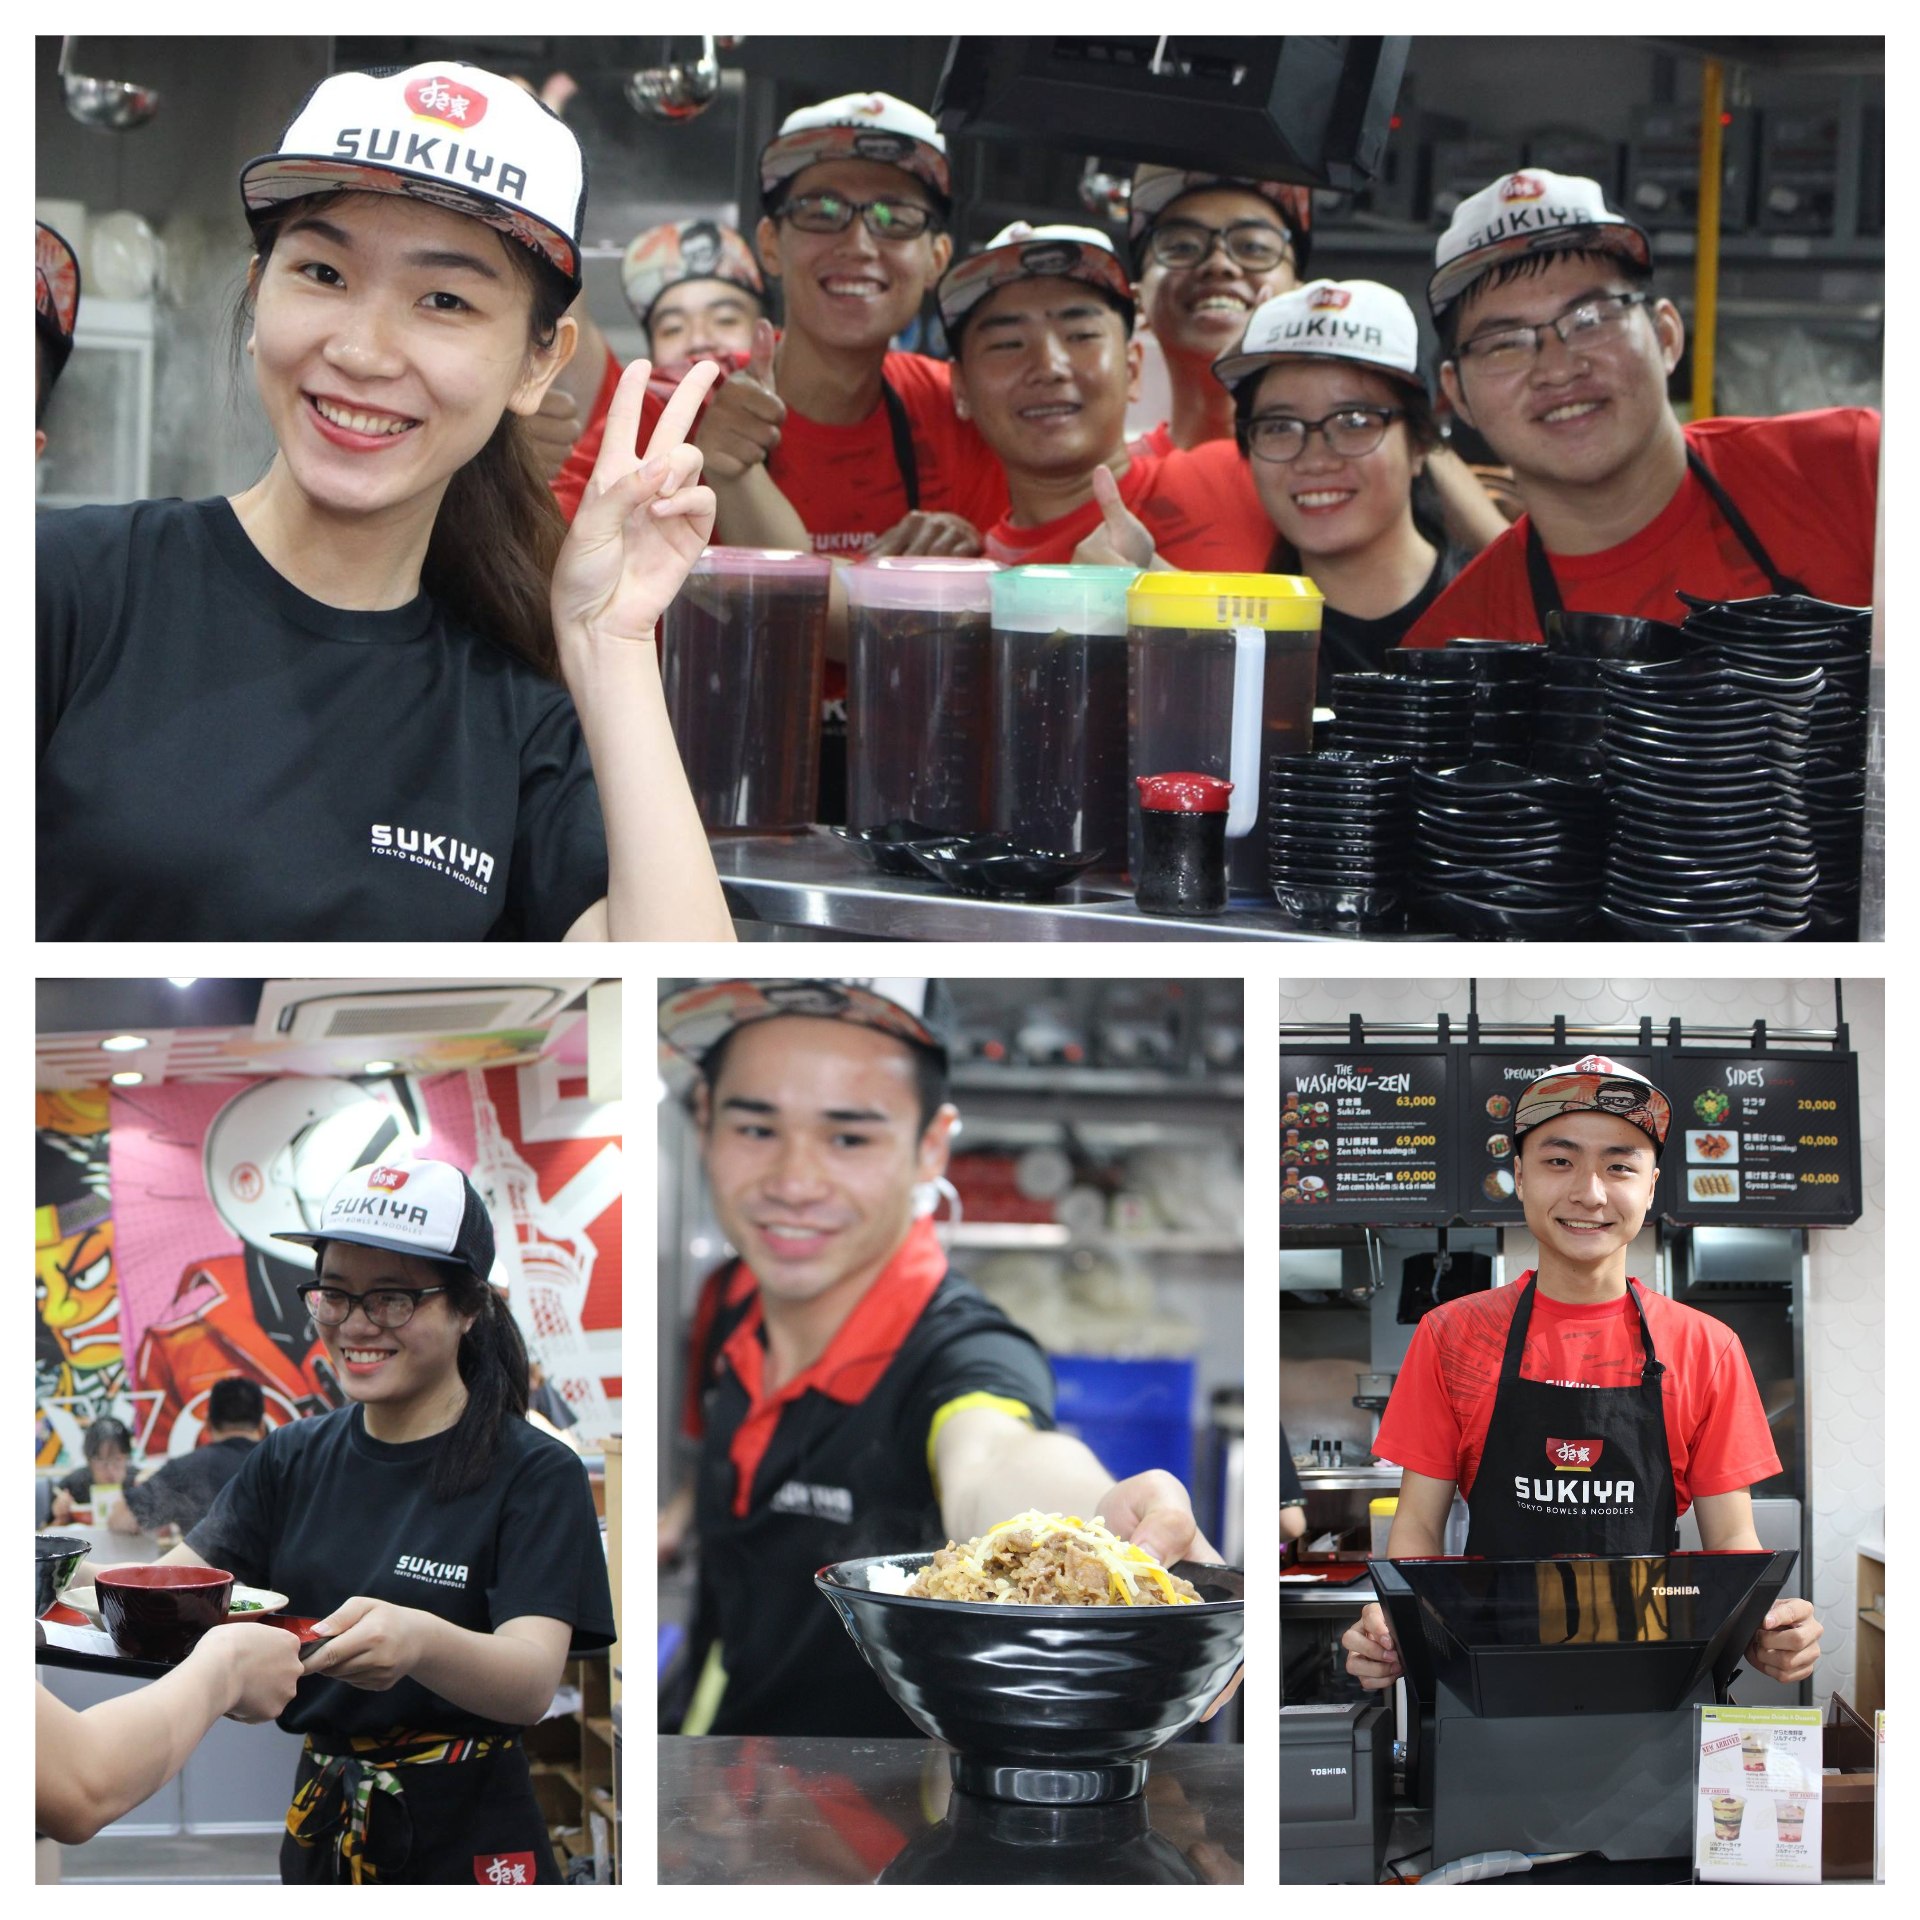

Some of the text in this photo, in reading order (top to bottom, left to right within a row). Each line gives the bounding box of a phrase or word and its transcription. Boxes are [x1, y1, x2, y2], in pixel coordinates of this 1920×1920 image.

[418, 79, 470, 120] すき家
[333, 128, 527, 201] SUKIYA
[1468, 206, 1593, 249] SUKIYA
[1265, 317, 1382, 346] SUKIYA
[371, 824, 494, 883] SUKIYA
[371, 846, 488, 895] TOKYO BOWLS & NOODLES
[1334, 1063, 1353, 1076] THE
[1726, 1066, 1764, 1088] SIDES
[1296, 1073, 1411, 1094] WASHOKU-ZEN
[1396, 1096, 1436, 1108] 63,000
[1798, 1099, 1836, 1112] 20,000
[1336, 1108, 1371, 1116] Suki Zen
[1396, 1135, 1436, 1148] 69,000
[1798, 1135, 1838, 1148] 40,000
[1396, 1170, 1436, 1183] 69,000
[1744, 1180, 1770, 1190] Gyoza
[1800, 1173, 1840, 1186] 40,000
[1336, 1183, 1350, 1191] Zen
[331, 1197, 428, 1226] SUKIYA
[382, 1220, 422, 1236] NOODLES
[1556, 1442, 1590, 1464] すき家
[1514, 1476, 1635, 1504] SUKIYA
[1517, 1500, 1543, 1512] TOKYO
[1546, 1506, 1578, 1515] BOWLS
[1590, 1507, 1634, 1515] NOODLES
[396, 1555, 469, 1582] SUKIYA
[394, 1569, 412, 1578] TOKYO
[412, 1573, 432, 1584] BOWLS
[438, 1580, 466, 1590] NOODLES
[1651, 1586, 1700, 1596] TOSHIBA
[1748, 1712, 1770, 1721] Japanese
[1702, 1736, 1740, 1754] NEW ARRIVED
[1310, 1768, 1347, 1776] TOSHIBA
[486, 1858, 526, 1885] すき家
